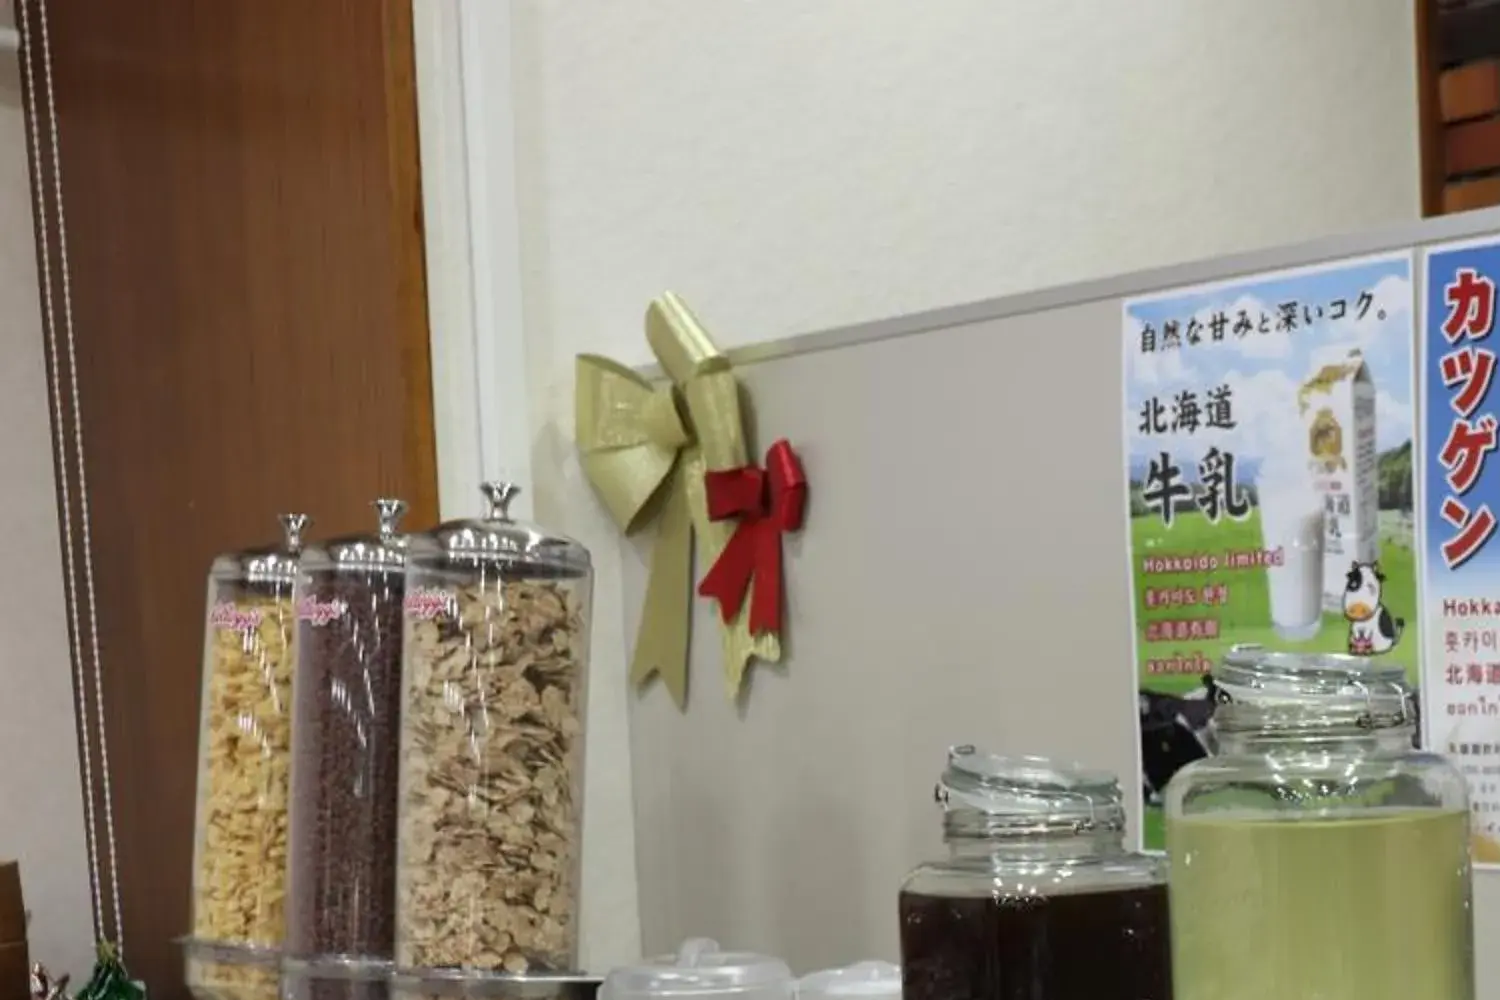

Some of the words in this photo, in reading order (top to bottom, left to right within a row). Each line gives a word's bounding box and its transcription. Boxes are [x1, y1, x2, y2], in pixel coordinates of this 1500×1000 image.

[1140, 291, 1388, 353] 自然な甘みと深いコク。
[1139, 384, 1237, 435] 北海道
[1440, 268, 1498, 567] カツゲン
[1143, 447, 1250, 525] 牛乳
